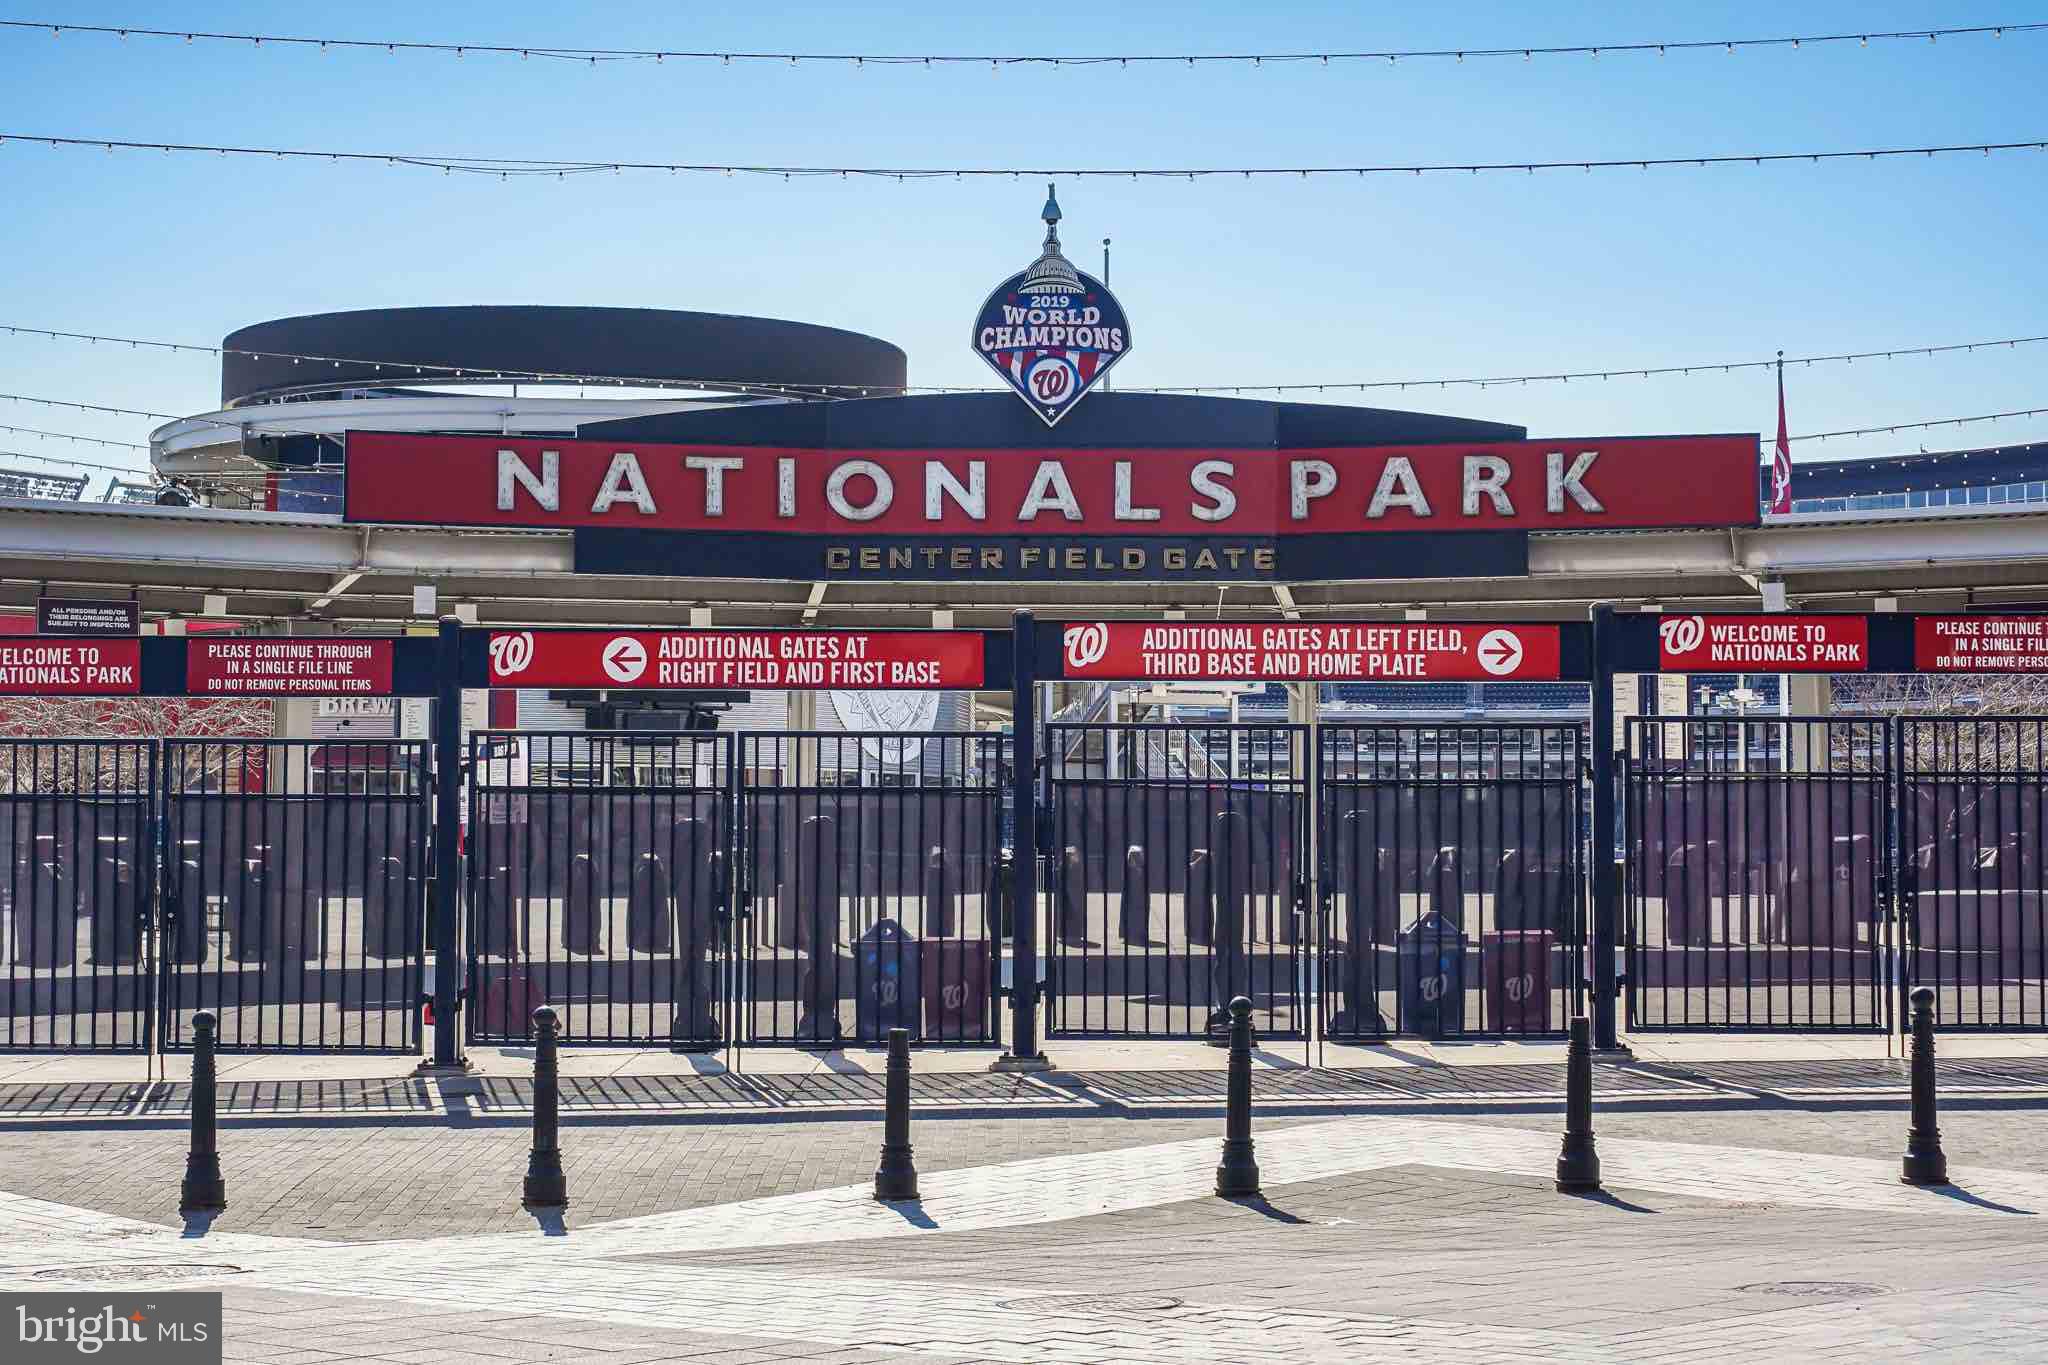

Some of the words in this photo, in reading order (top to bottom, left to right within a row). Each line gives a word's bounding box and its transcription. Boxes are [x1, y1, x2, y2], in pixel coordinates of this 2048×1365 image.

[1031, 295, 1070, 308] 2019
[1002, 305, 1100, 325] WORLD
[980, 327, 1123, 352] CHAMPIONS
[1033, 365, 1068, 400] W
[496, 449, 1239, 522] NATIONALS
[1290, 451, 1605, 520] PARK
[826, 547, 1004, 570] CENTER
[1020, 547, 1147, 570] FIELD
[1162, 547, 1276, 570] GATE
[65, 607, 98, 615] PERSONS
[1711, 624, 1799, 643] WELCOME
[1803, 625, 1826, 642] TO
[1936, 621, 1980, 635] PLEASE
[1983, 621, 2043, 635] CONTINUE
[658, 636, 774, 659] ADDITIONAL
[780, 636, 840, 659] GATES
[845, 636, 868, 659] AT
[1142, 628, 1257, 650] ADDITIONAL
[1262, 628, 1322, 650] GATES
[1327, 628, 1351, 650] AT
[1356, 628, 1401, 650] LEFT
[1407, 628, 1468, 655] FIELD,
[1955, 637, 1968, 651] IN
[1971, 637, 1979, 651] A
[1982, 637, 2024, 651] SINGLE
[0, 647, 72, 665] ELCOME
[78, 647, 99, 665] TO
[208, 644, 252, 659] PLEASE
[255, 644, 313, 659] CONTINUE
[317, 645, 372, 659] THROUGH
[1711, 644, 1807, 661] NATIONALS
[1812, 644, 1861, 661] PARK
[227, 660, 239, 674] IN
[242, 661, 251, 674] A
[254, 661, 295, 674] SINGLE
[298, 661, 323, 674] FILE
[327, 661, 353, 674] LINE
[1142, 653, 1201, 676] THIRD
[1207, 653, 1256, 676] BASE
[1261, 653, 1301, 676] AND
[1307, 653, 1363, 676] HOME
[1368, 653, 1427, 676] PLATE
[1936, 656, 1951, 667] DO
[1953, 656, 1972, 667] NOT
[1975, 656, 2015, 667] REMOVE
[86, 666, 133, 684] PARK
[658, 661, 718, 684] RIGHT
[723, 661, 779, 684] FIELD
[784, 661, 824, 684] AND
[830, 661, 886, 684] FIRST
[891, 661, 941, 684] BASE
[208, 678, 222, 690] DO
[224, 678, 244, 690] NOT
[246, 678, 287, 690] REMOVE
[289, 679, 340, 691] PERSONAL
[342, 679, 372, 691] ITEMS
[326, 697, 393, 714] BREW
